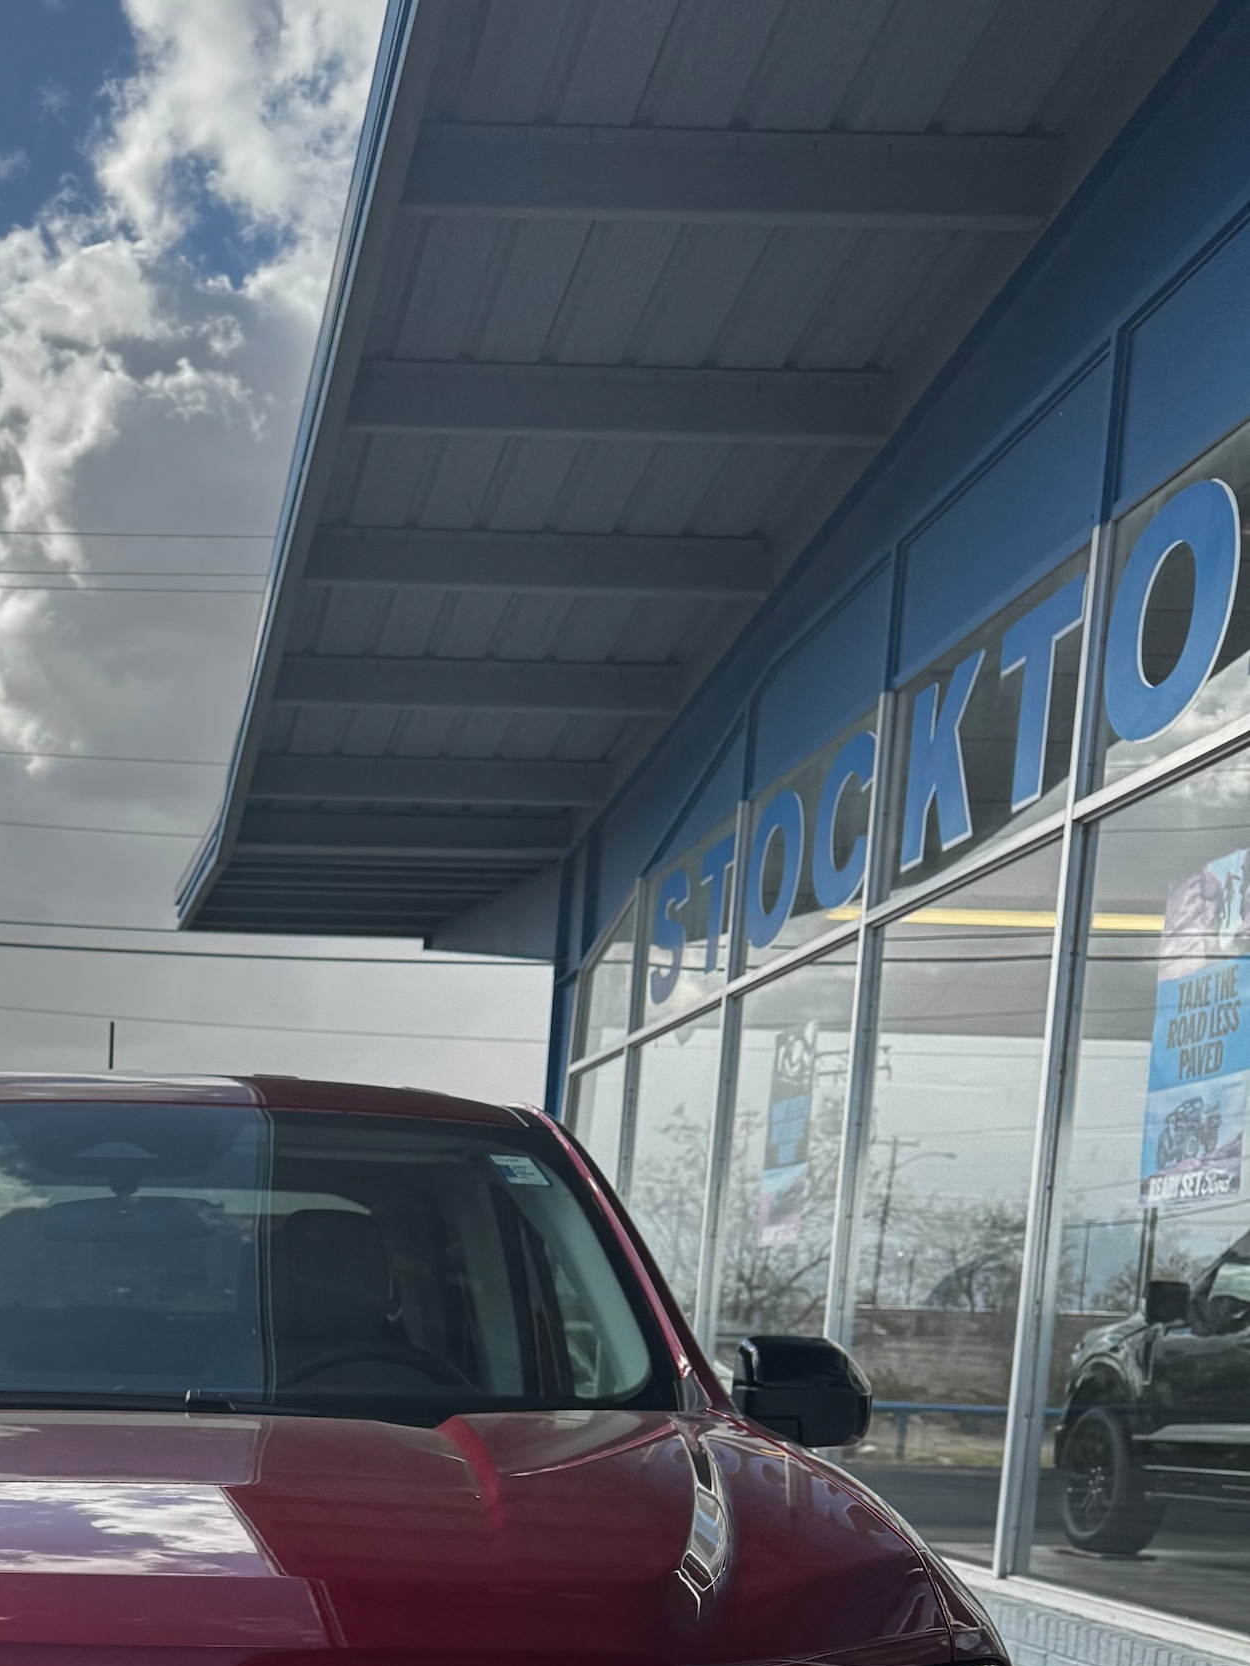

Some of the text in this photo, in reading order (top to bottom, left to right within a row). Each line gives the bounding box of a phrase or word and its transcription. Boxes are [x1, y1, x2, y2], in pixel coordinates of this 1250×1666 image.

[649, 477, 1250, 1006] STOCKTO
[1177, 963, 1239, 1014] TAKE THE
[1166, 999, 1242, 1049] ROAD LESS
[1177, 1040, 1224, 1080] PAVED
